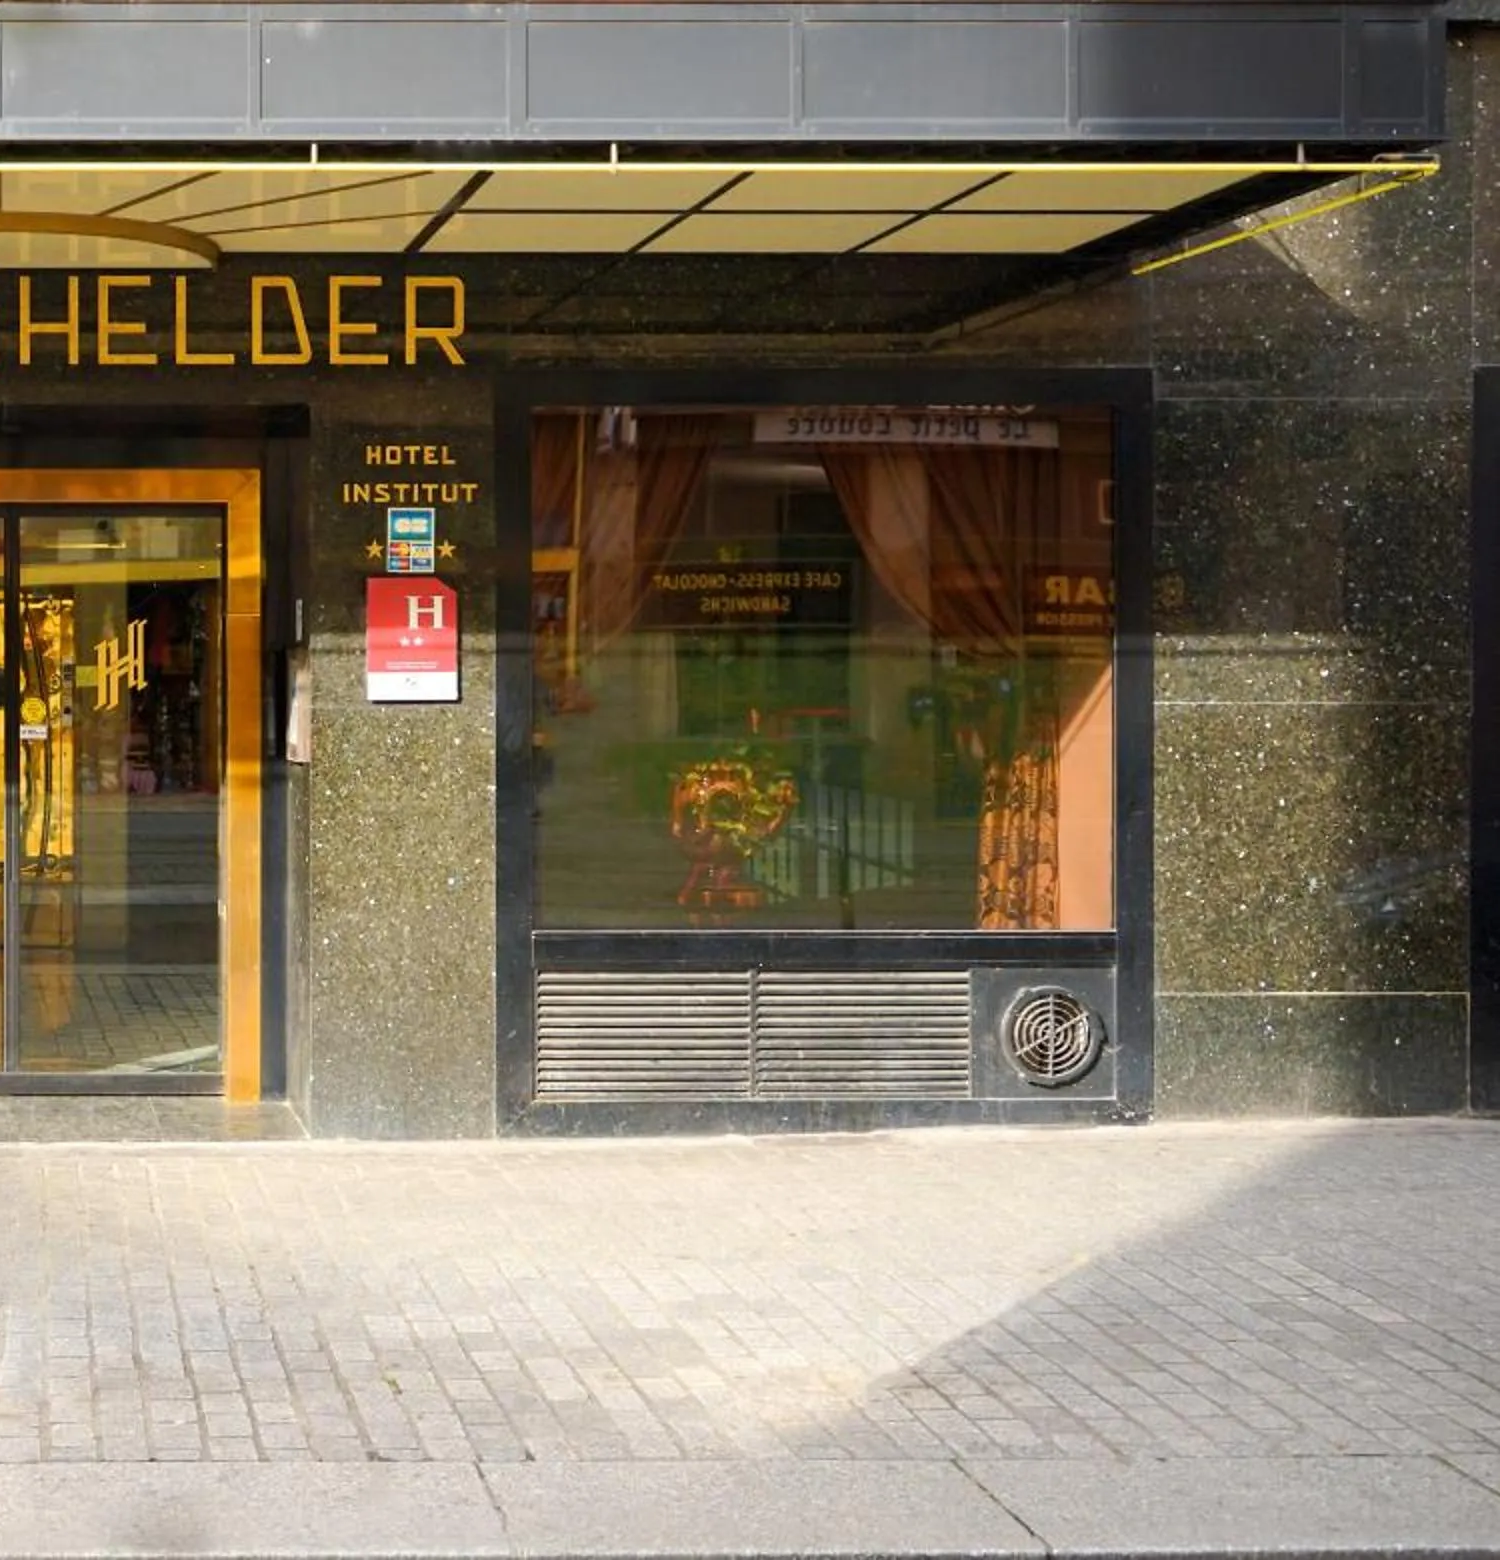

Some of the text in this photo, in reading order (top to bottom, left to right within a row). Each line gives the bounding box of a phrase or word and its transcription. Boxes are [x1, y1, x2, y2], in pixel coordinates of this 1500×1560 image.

[19, 275, 466, 366] HELDER
[366, 445, 456, 465] HOTEL
[343, 483, 479, 503] INSTITUT
[406, 594, 446, 630] H
